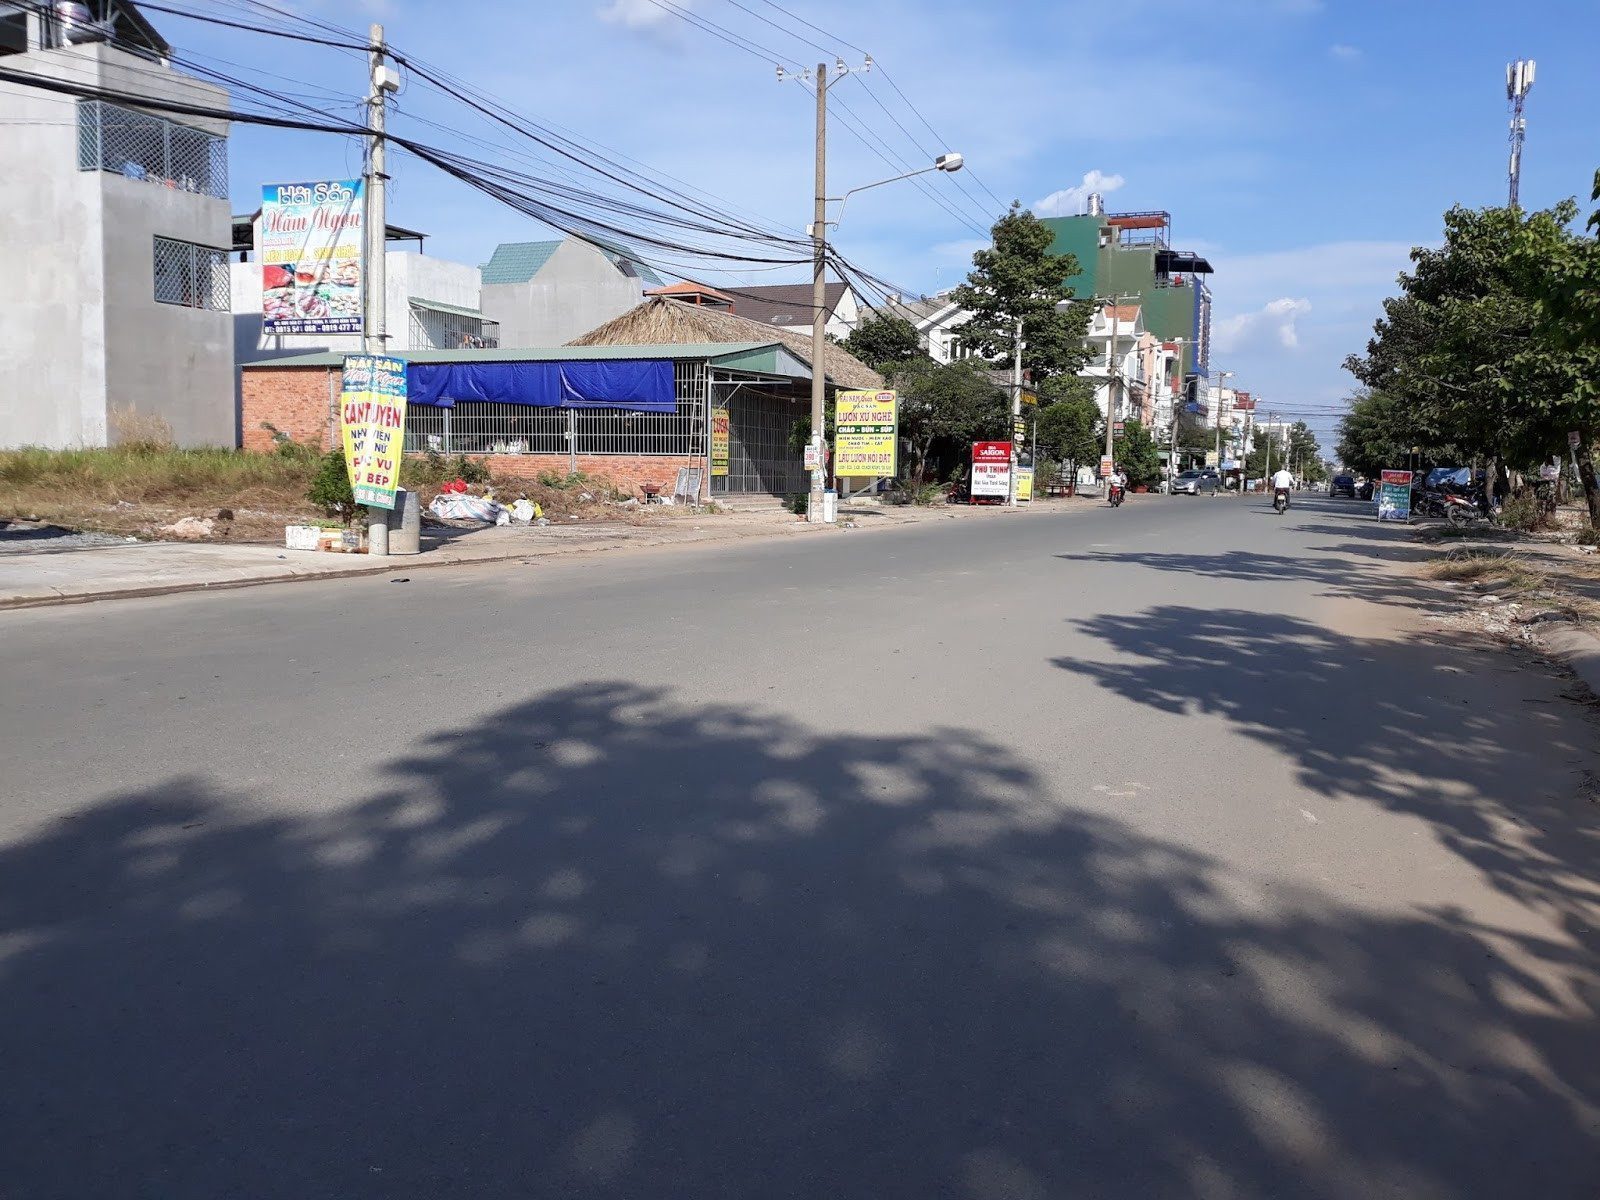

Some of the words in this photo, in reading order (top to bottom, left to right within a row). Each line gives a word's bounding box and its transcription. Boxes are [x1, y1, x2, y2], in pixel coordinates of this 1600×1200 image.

[278, 186, 311, 205] Hải
[314, 182, 354, 203] Sản
[880, 425, 893, 433] SÚP
